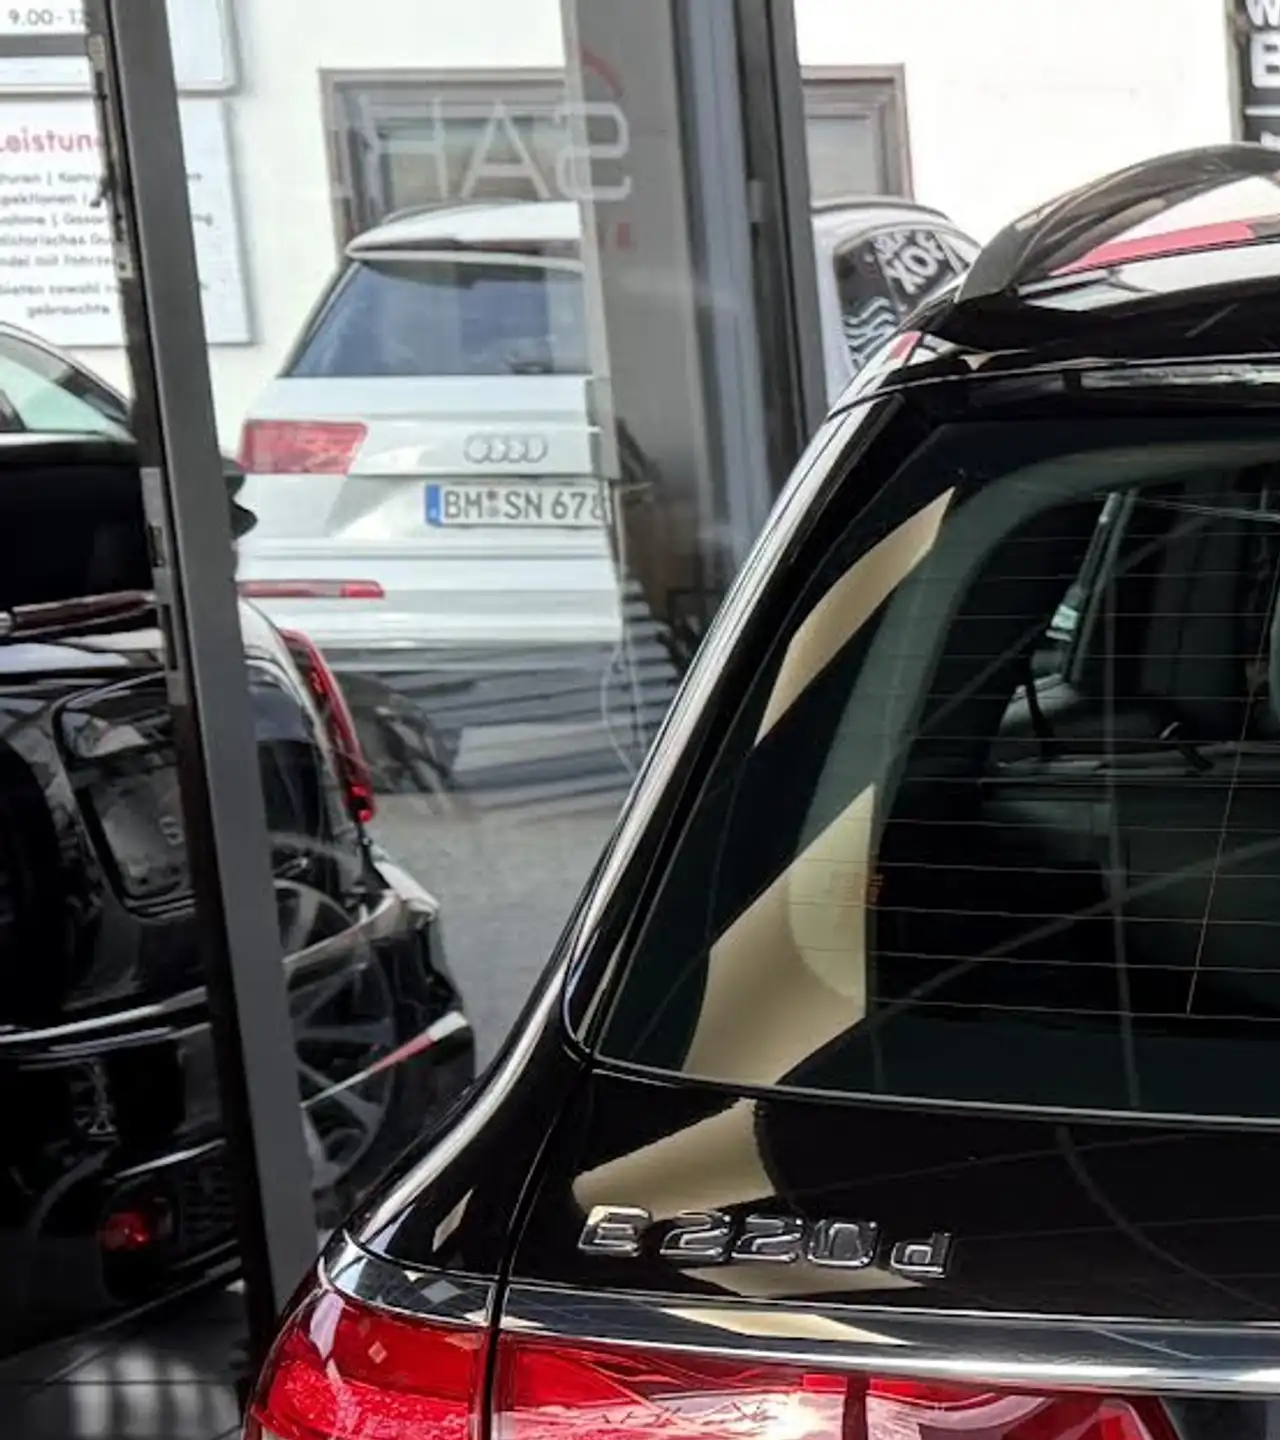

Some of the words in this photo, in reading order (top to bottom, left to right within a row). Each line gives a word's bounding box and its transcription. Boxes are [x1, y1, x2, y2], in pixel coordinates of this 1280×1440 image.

[0, 126, 103, 153] eistun
[444, 490, 483, 518] BM
[503, 490, 543, 519] SN
[577, 1205, 652, 1258] E
